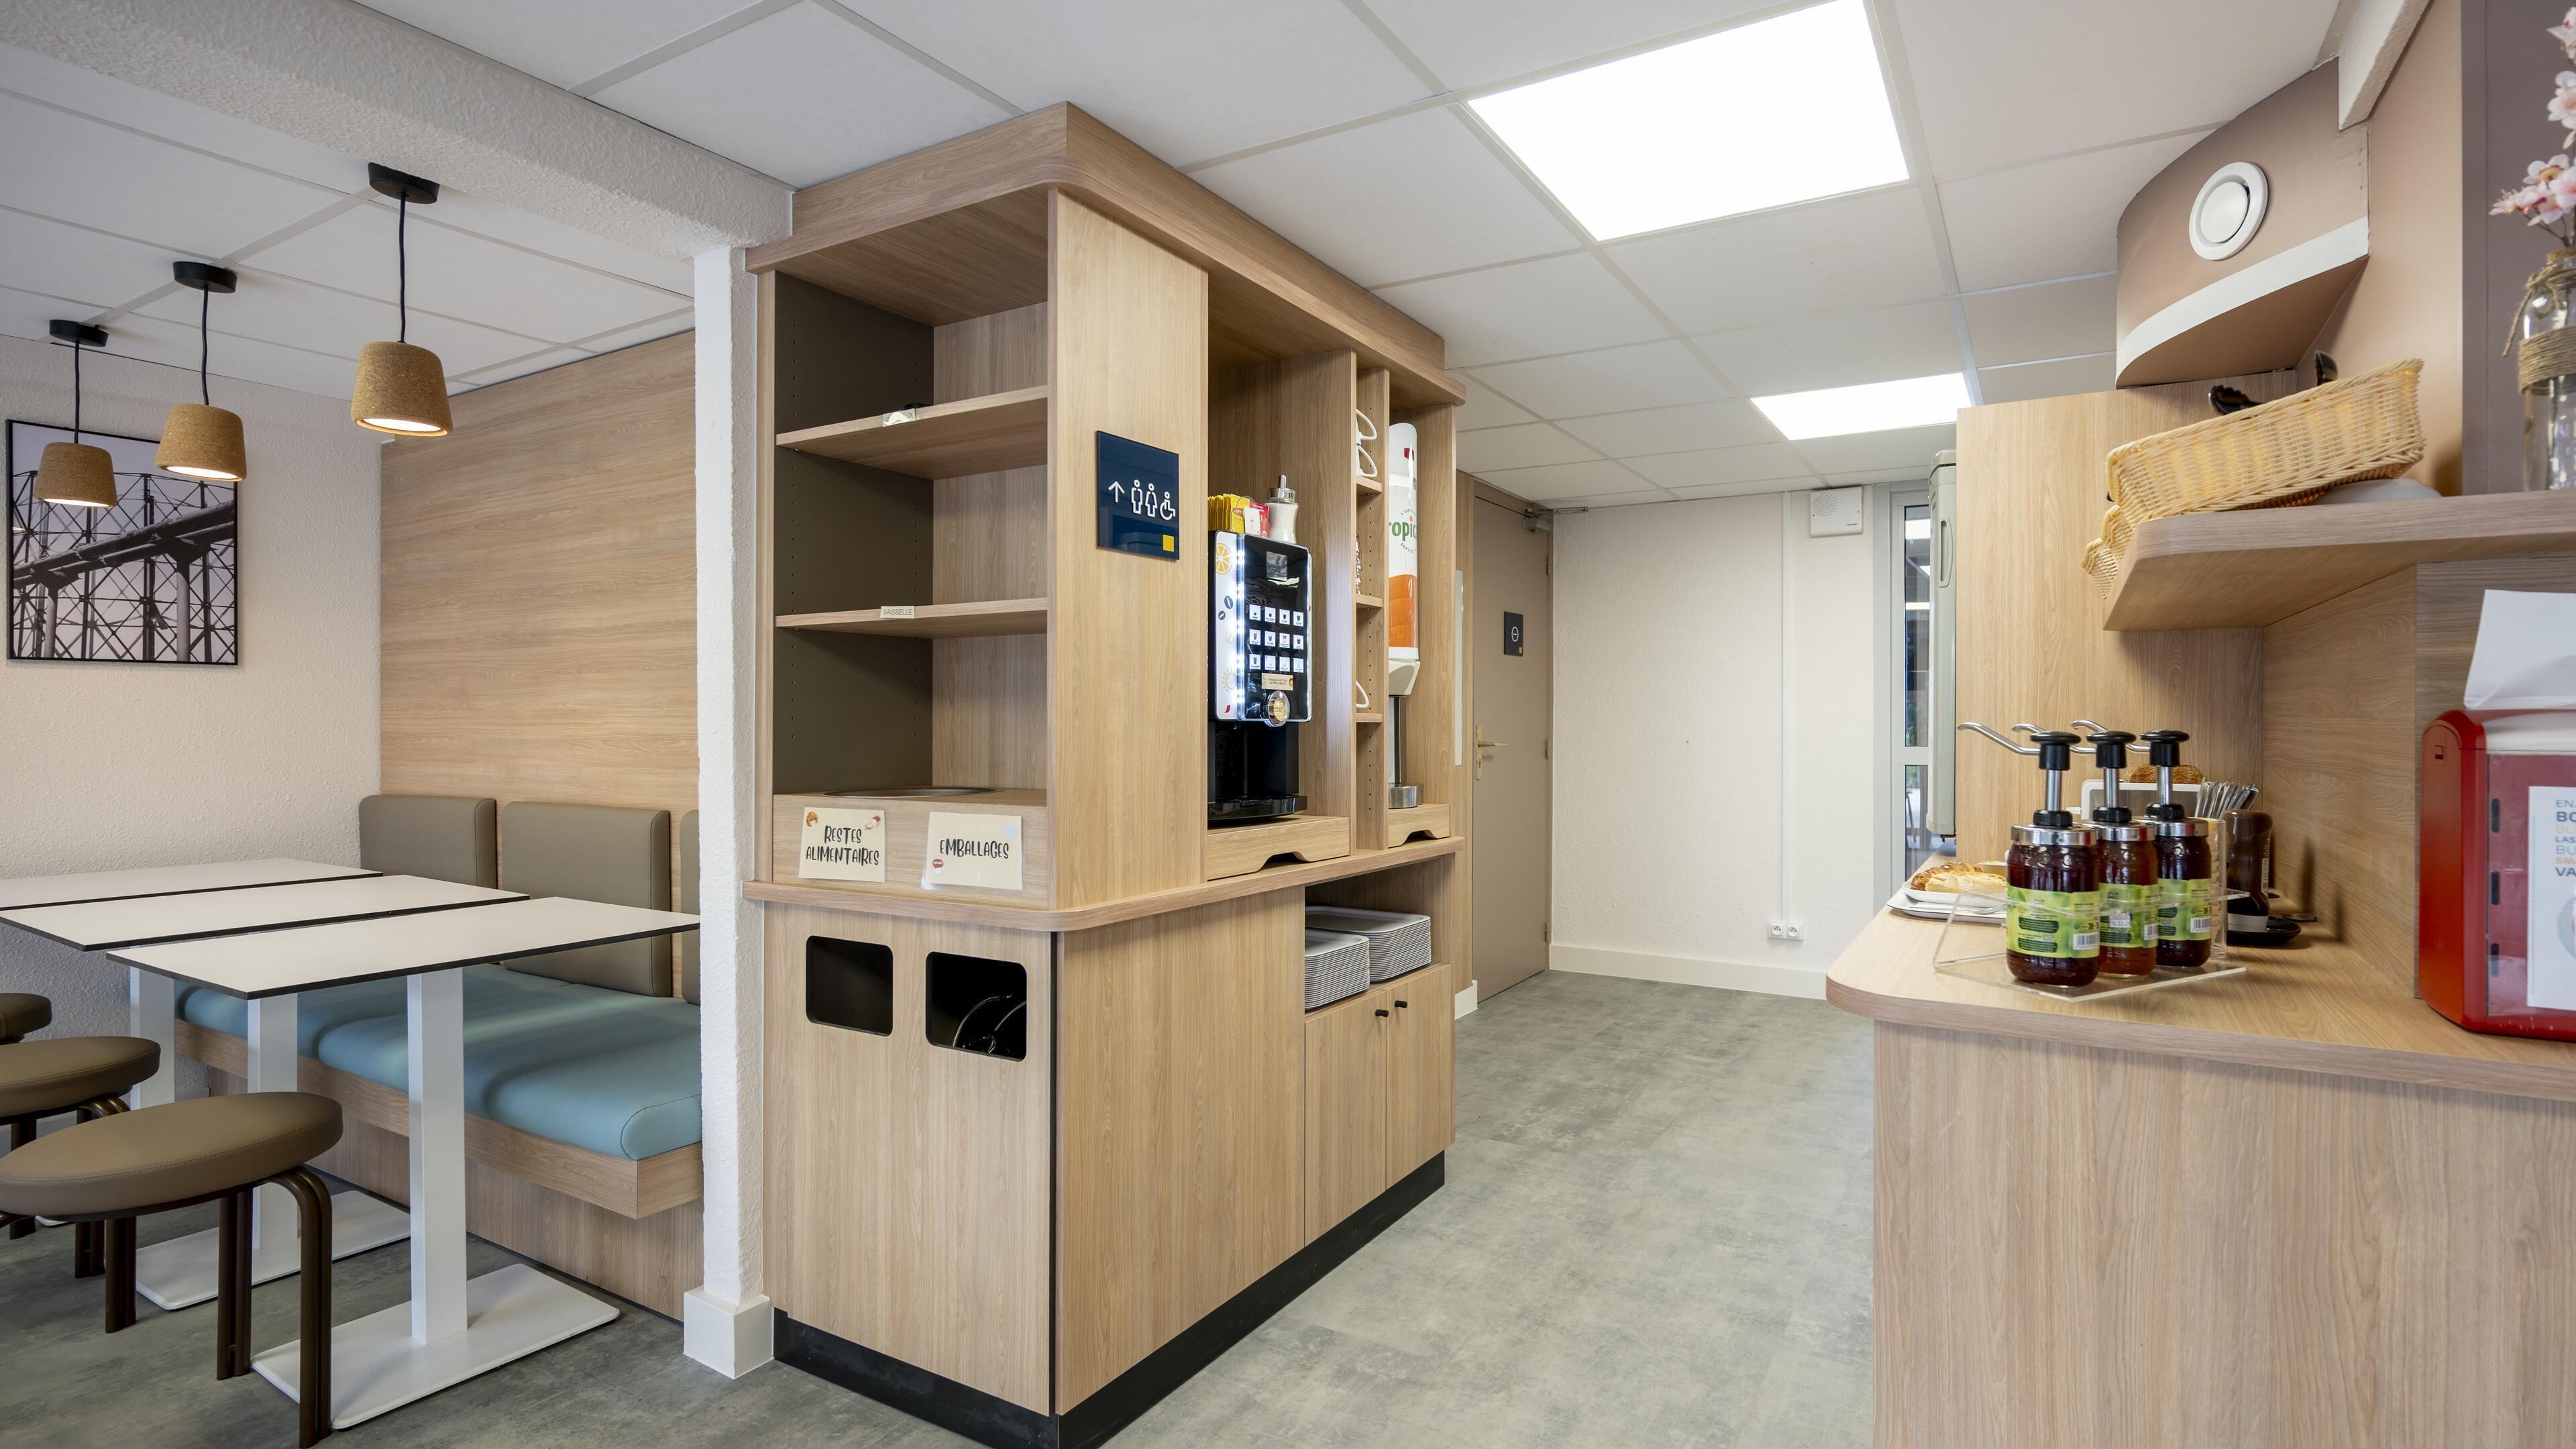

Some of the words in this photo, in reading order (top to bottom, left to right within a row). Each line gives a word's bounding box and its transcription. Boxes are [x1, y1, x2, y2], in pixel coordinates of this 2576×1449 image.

[2555, 799, 2576, 808] EN
[824, 825, 862, 845] RESTES
[806, 845, 879, 866] ALIMENTAIRES
[940, 838, 1009, 859] EMBALLAGES
